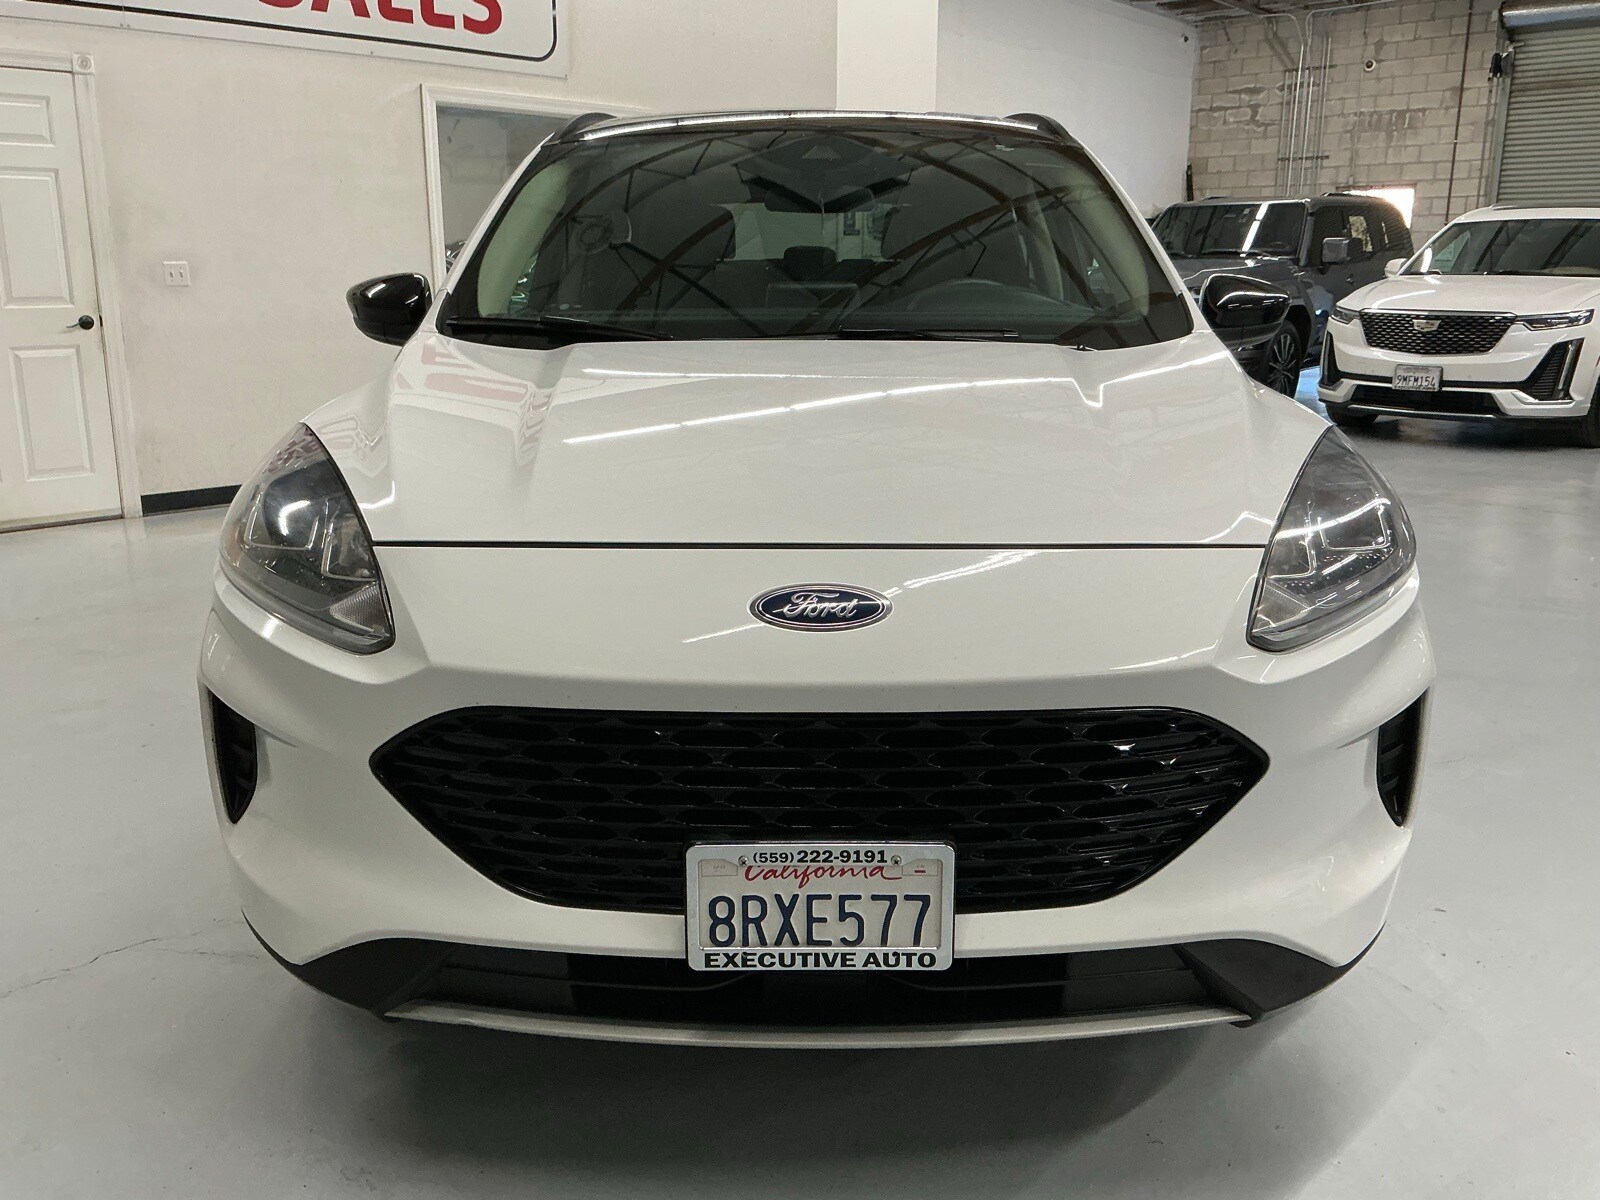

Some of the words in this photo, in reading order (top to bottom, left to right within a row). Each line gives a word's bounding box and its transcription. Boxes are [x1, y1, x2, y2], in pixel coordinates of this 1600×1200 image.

[1397, 375, 1436, 387] 9MFM154
[772, 592, 862, 618] Ford
[753, 852, 794, 863] (559)
[797, 850, 887, 863] 222-9191
[708, 893, 931, 947] 8RXE577
[704, 952, 857, 968] EXECUTIVE
[862, 952, 937, 968] AUTO
